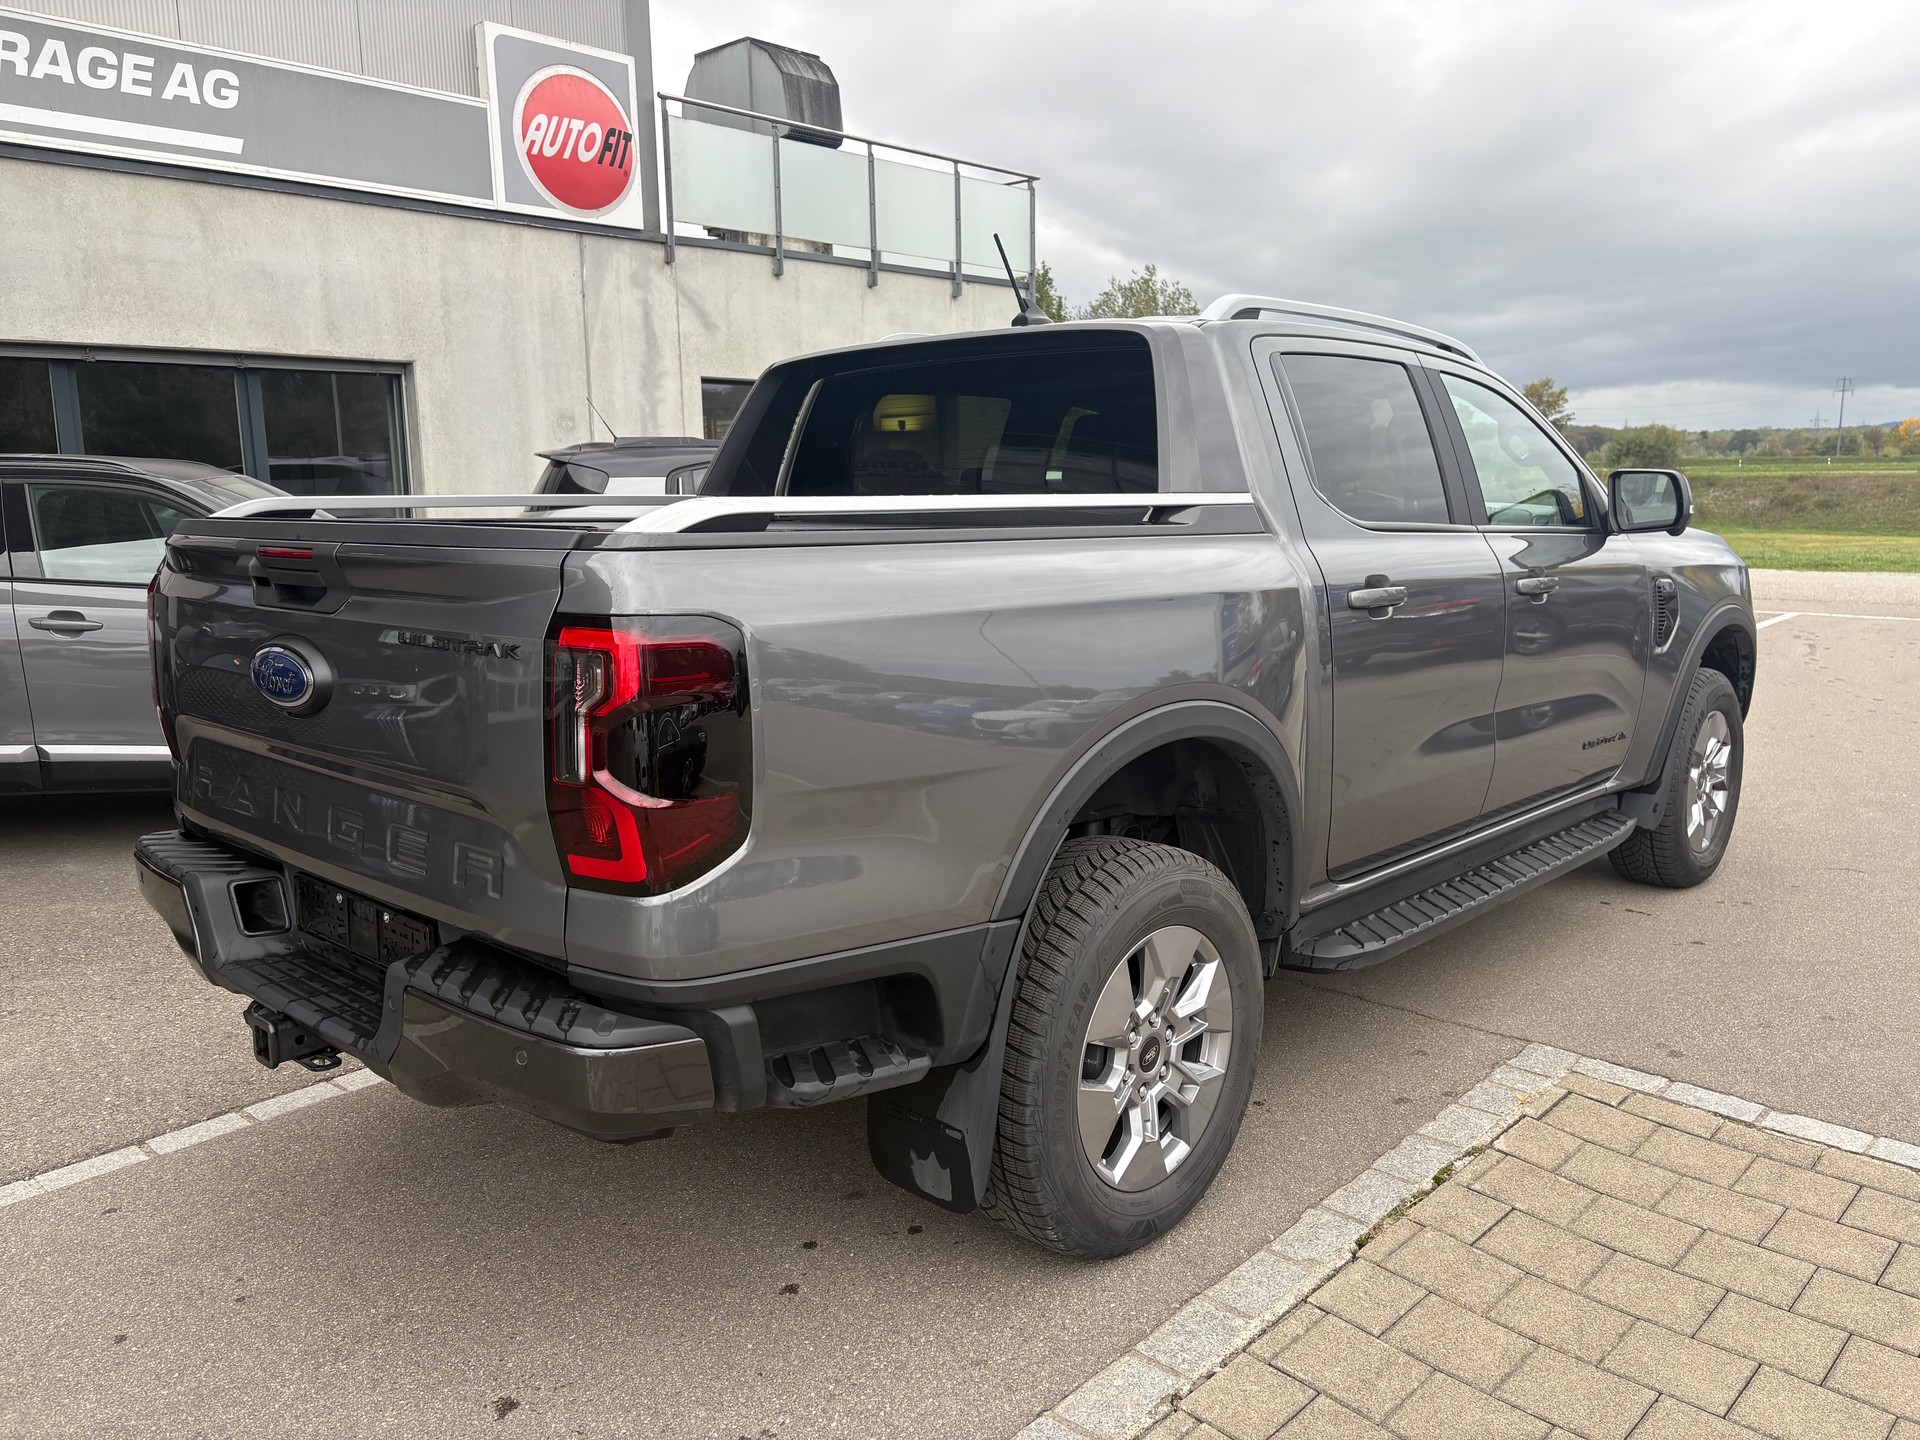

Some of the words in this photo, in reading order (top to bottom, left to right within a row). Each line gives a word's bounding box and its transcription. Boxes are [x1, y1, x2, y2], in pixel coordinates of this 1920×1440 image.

[0, 29, 155, 97] RAGE
[161, 62, 240, 109] AG
[524, 113, 633, 170] AUTOFIT
[256, 656, 298, 696] Ford
[195, 765, 505, 900] RANGER
